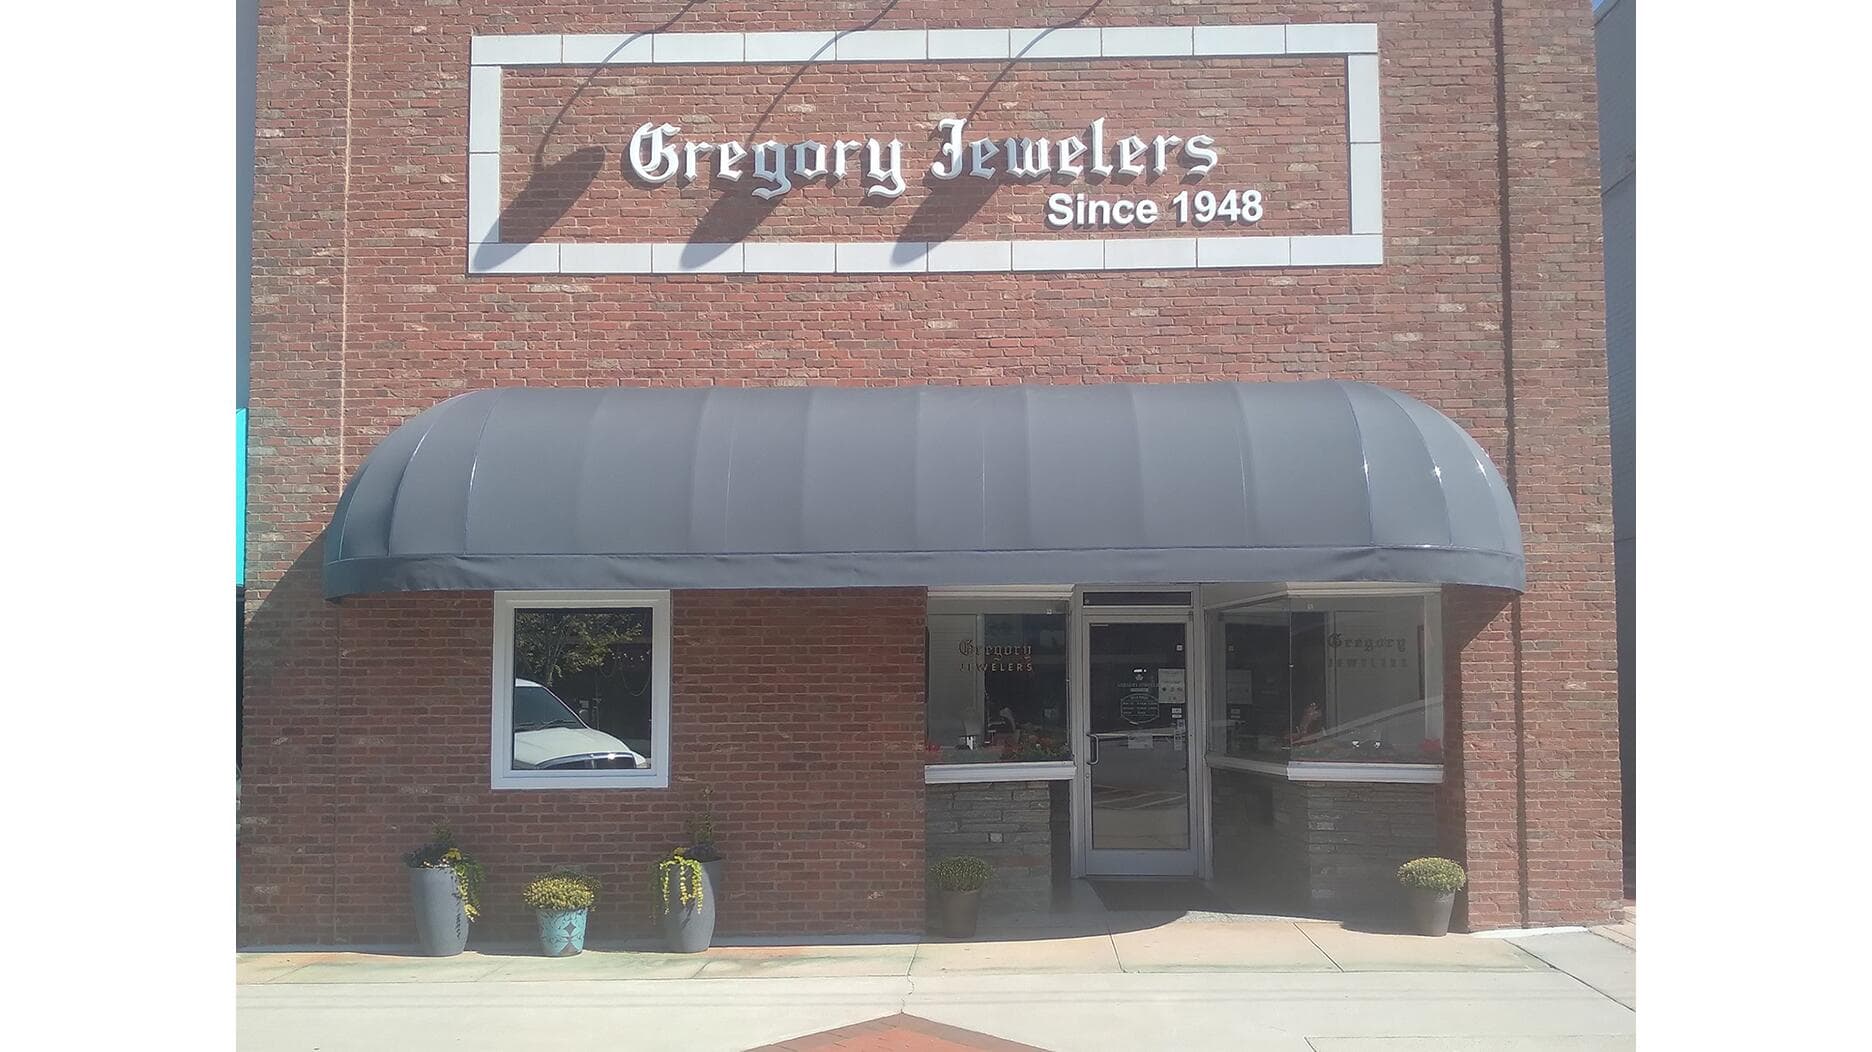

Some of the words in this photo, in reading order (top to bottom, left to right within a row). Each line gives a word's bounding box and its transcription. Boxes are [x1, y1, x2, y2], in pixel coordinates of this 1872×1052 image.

[629, 121, 906, 200] Gregory
[930, 117, 1220, 181] Jewelers
[1047, 194, 1160, 226] Since
[1171, 190, 1264, 223] 1948
[959, 639, 1032, 661] Gregory
[1327, 632, 1407, 653] Gregory
